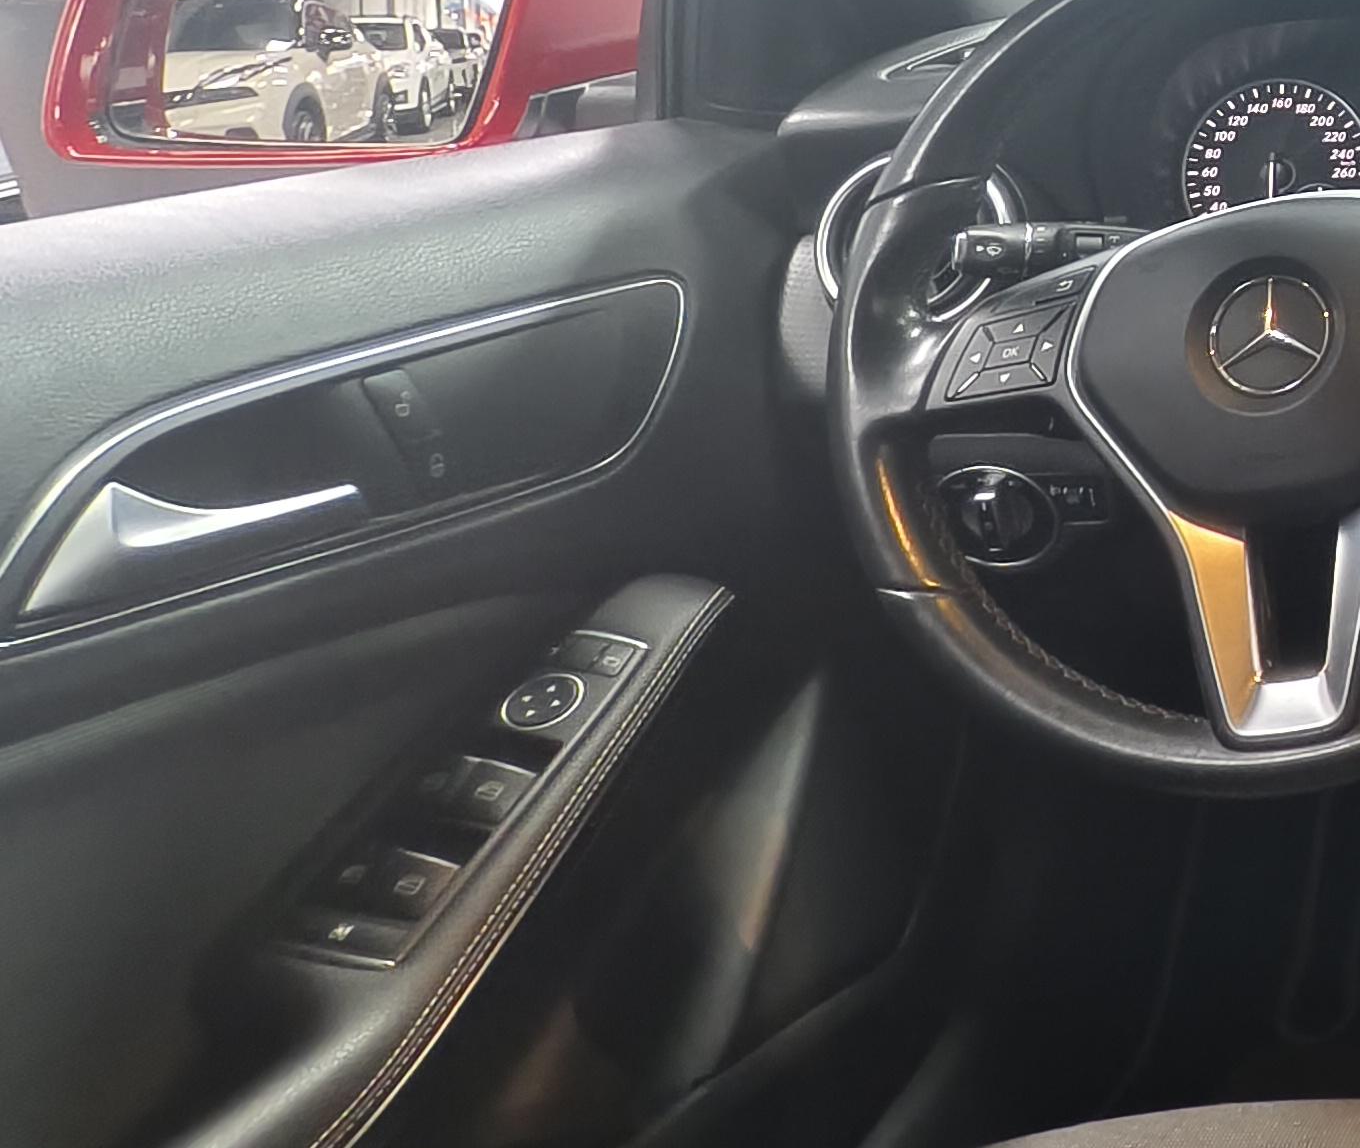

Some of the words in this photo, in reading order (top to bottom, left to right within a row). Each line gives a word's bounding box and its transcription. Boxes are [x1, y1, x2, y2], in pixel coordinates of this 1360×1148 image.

[1272, 97, 1292, 108] 160
[1247, 103, 1268, 114] 140
[1295, 103, 1316, 114] 180
[1228, 115, 1249, 127] 120
[1309, 115, 1335, 127] 200
[1214, 131, 1236, 142] 100
[1322, 131, 1347, 143] 220
[1205, 148, 1222, 159] 80
[1330, 149, 1354, 160] 240
[1202, 167, 1218, 178] 60
[1331, 167, 1356, 179] 260
[1203, 185, 1220, 197] 50
[1002, 346, 1019, 358] OK
